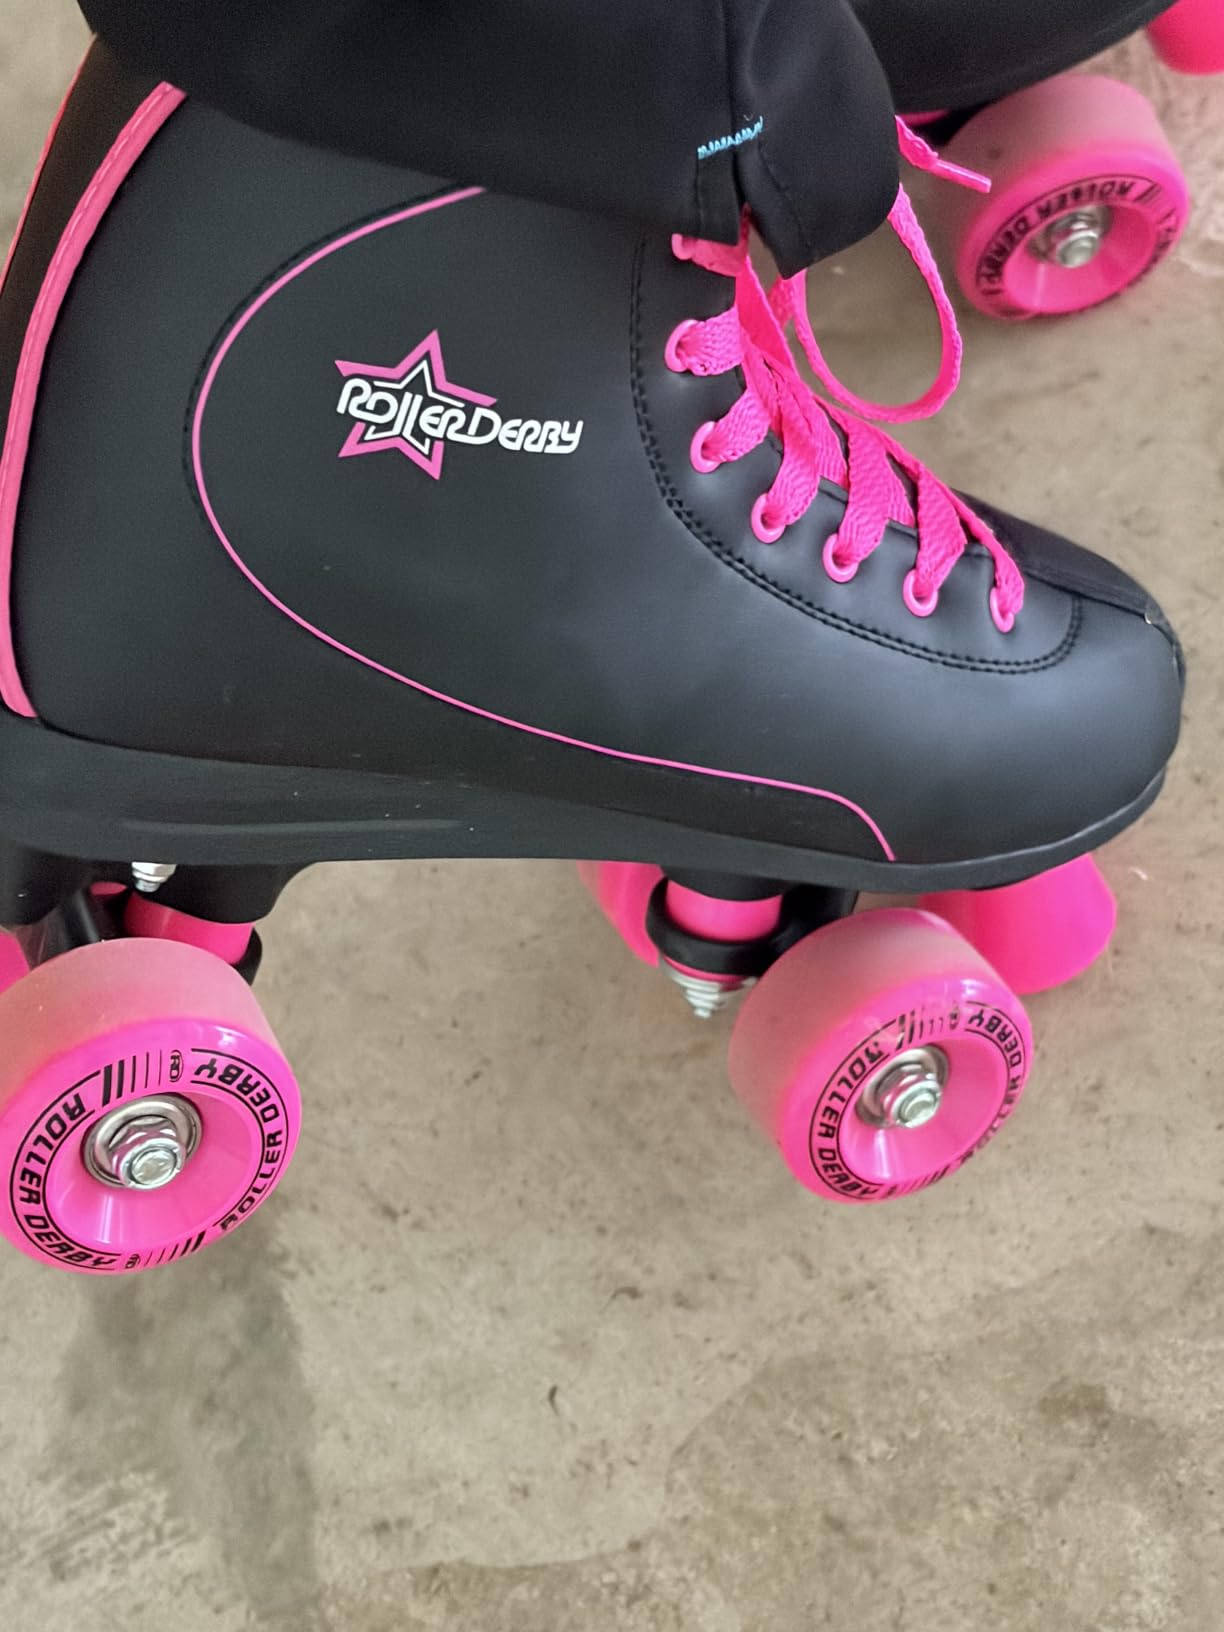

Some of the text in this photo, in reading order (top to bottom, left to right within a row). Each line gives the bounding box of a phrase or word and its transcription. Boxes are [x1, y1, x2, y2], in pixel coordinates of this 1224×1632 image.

[19, 1093, 116, 1268] ROLLER DERBY
[194, 1058, 283, 1231] ROLLER DERBY
